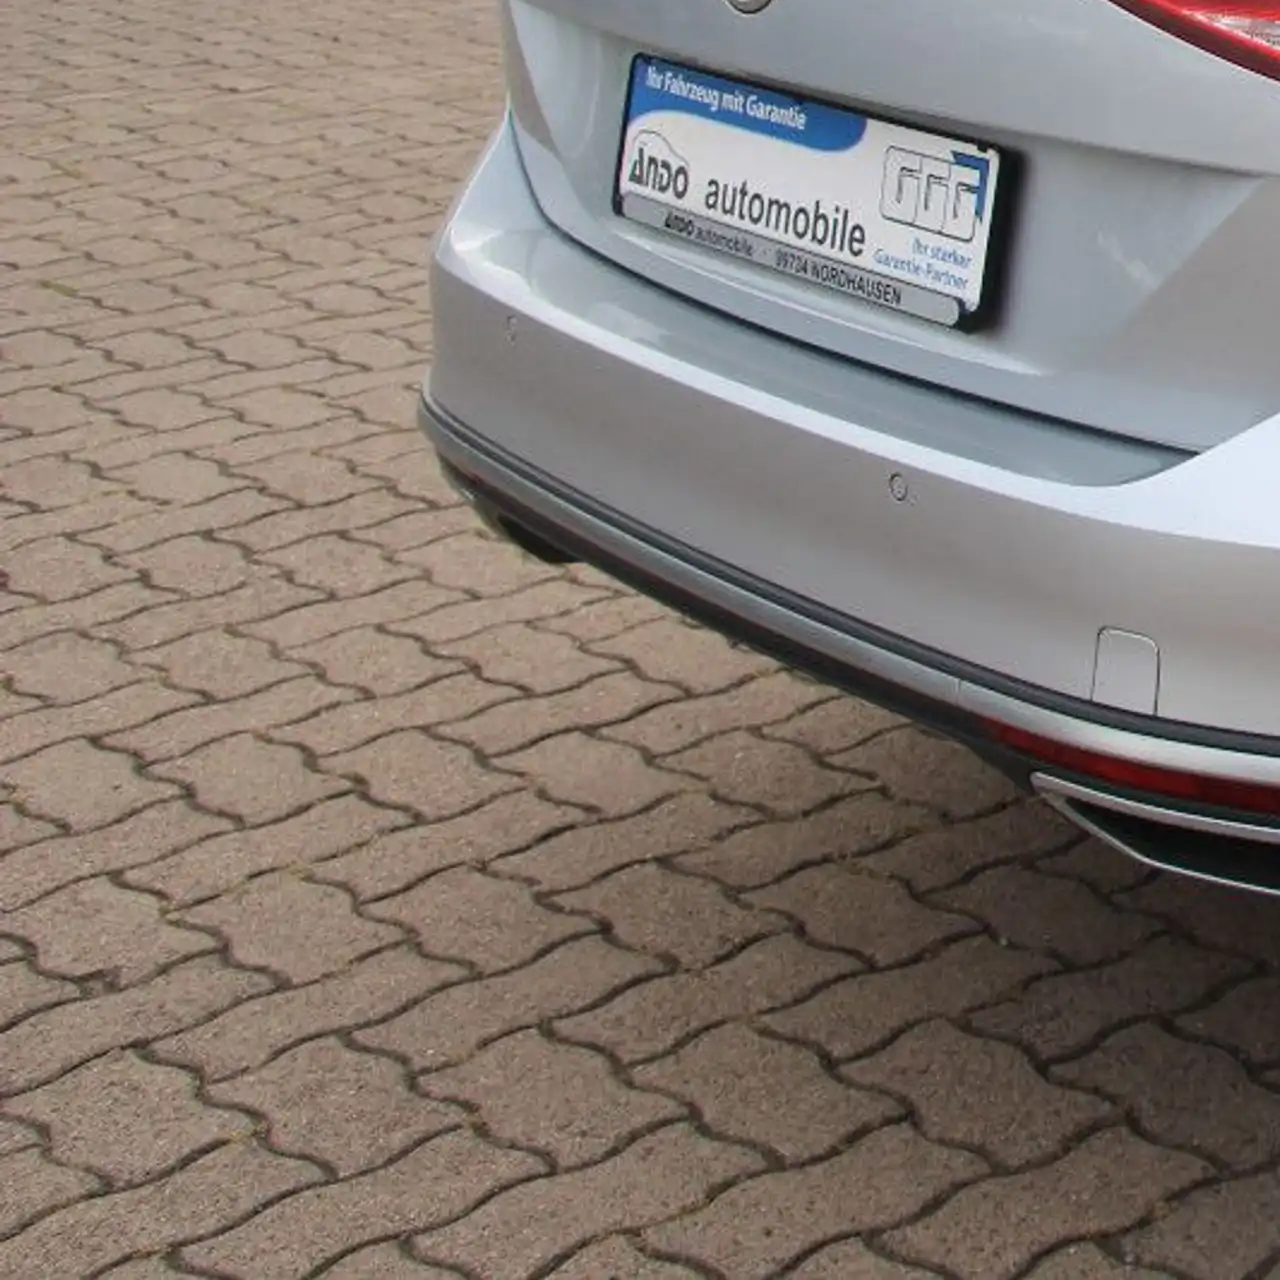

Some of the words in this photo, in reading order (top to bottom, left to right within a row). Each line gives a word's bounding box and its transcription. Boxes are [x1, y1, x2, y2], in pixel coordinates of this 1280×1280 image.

[645, 65, 664, 91] Ihr
[664, 72, 720, 112] Fahrzeug
[722, 89, 745, 114] mit
[746, 94, 808, 131] Garantie
[705, 177, 866, 258] automobile
[696, 226, 754, 257] automobile
[811, 260, 902, 305] NORDHAUSEN
